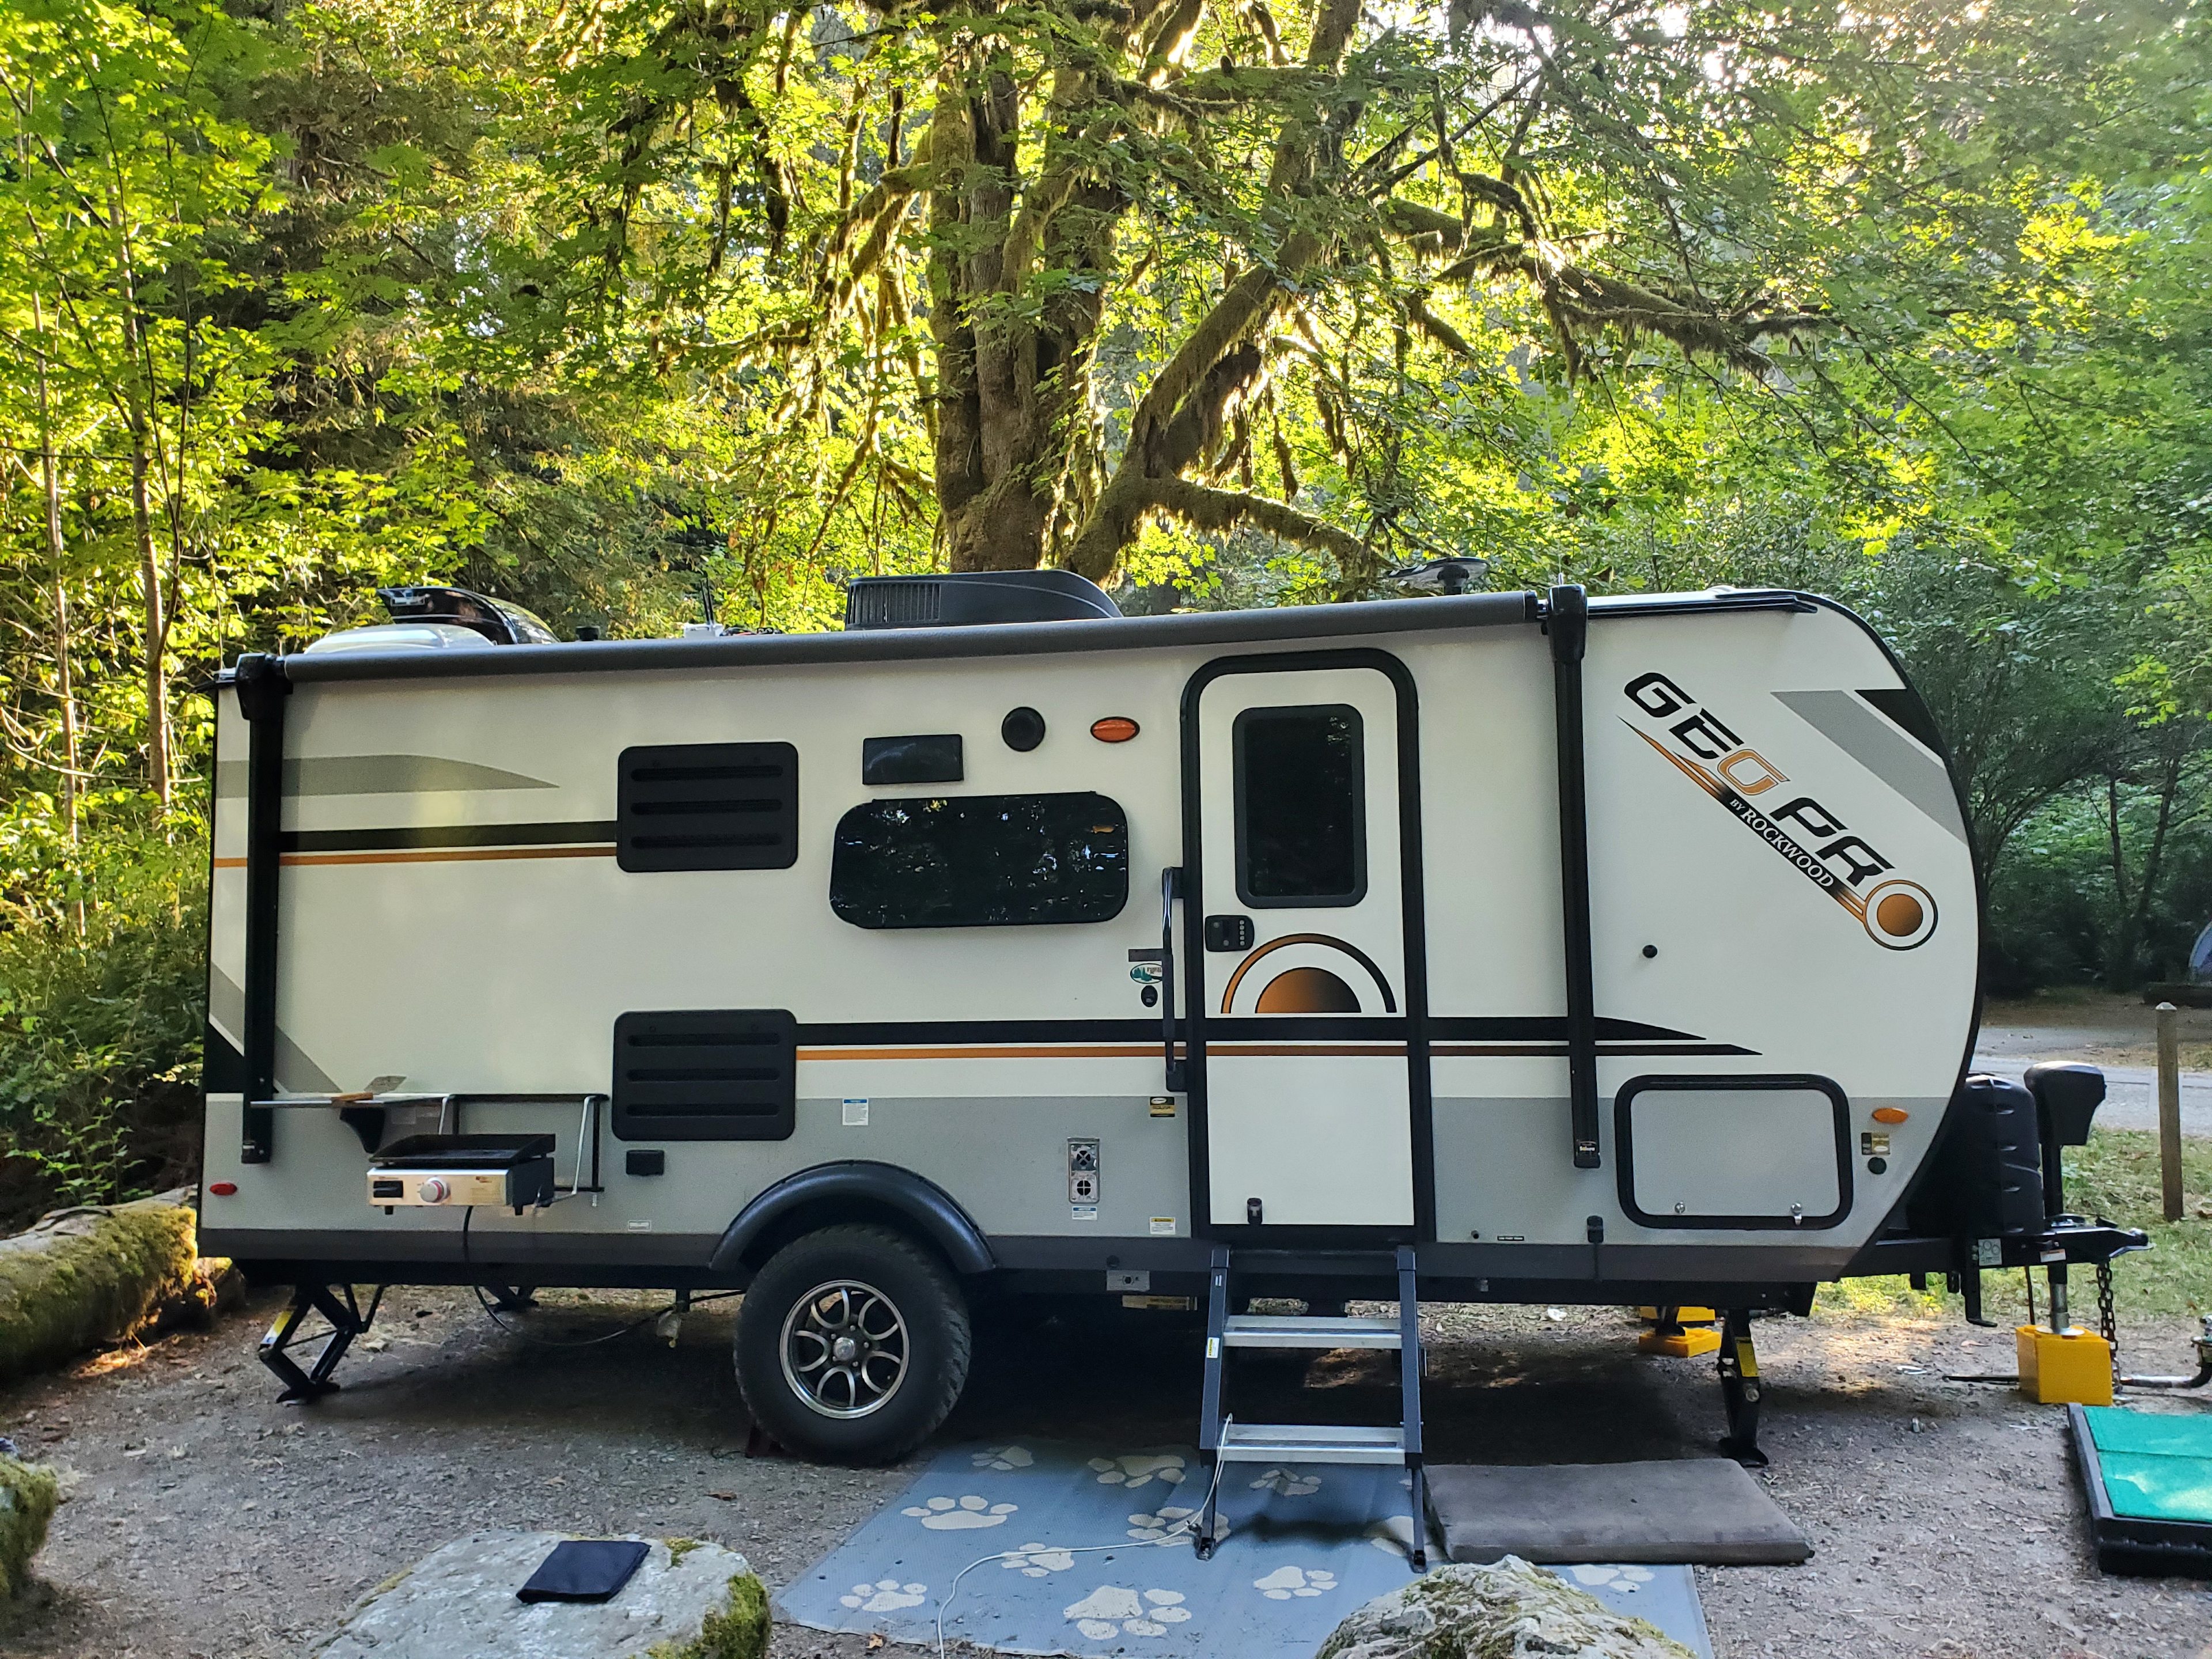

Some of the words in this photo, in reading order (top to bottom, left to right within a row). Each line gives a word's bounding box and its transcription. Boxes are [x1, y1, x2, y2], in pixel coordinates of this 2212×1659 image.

[1624, 672, 1790, 796] GEO
[1729, 798, 1746, 810] BY
[1740, 808, 1834, 887] ROCKWOOD
